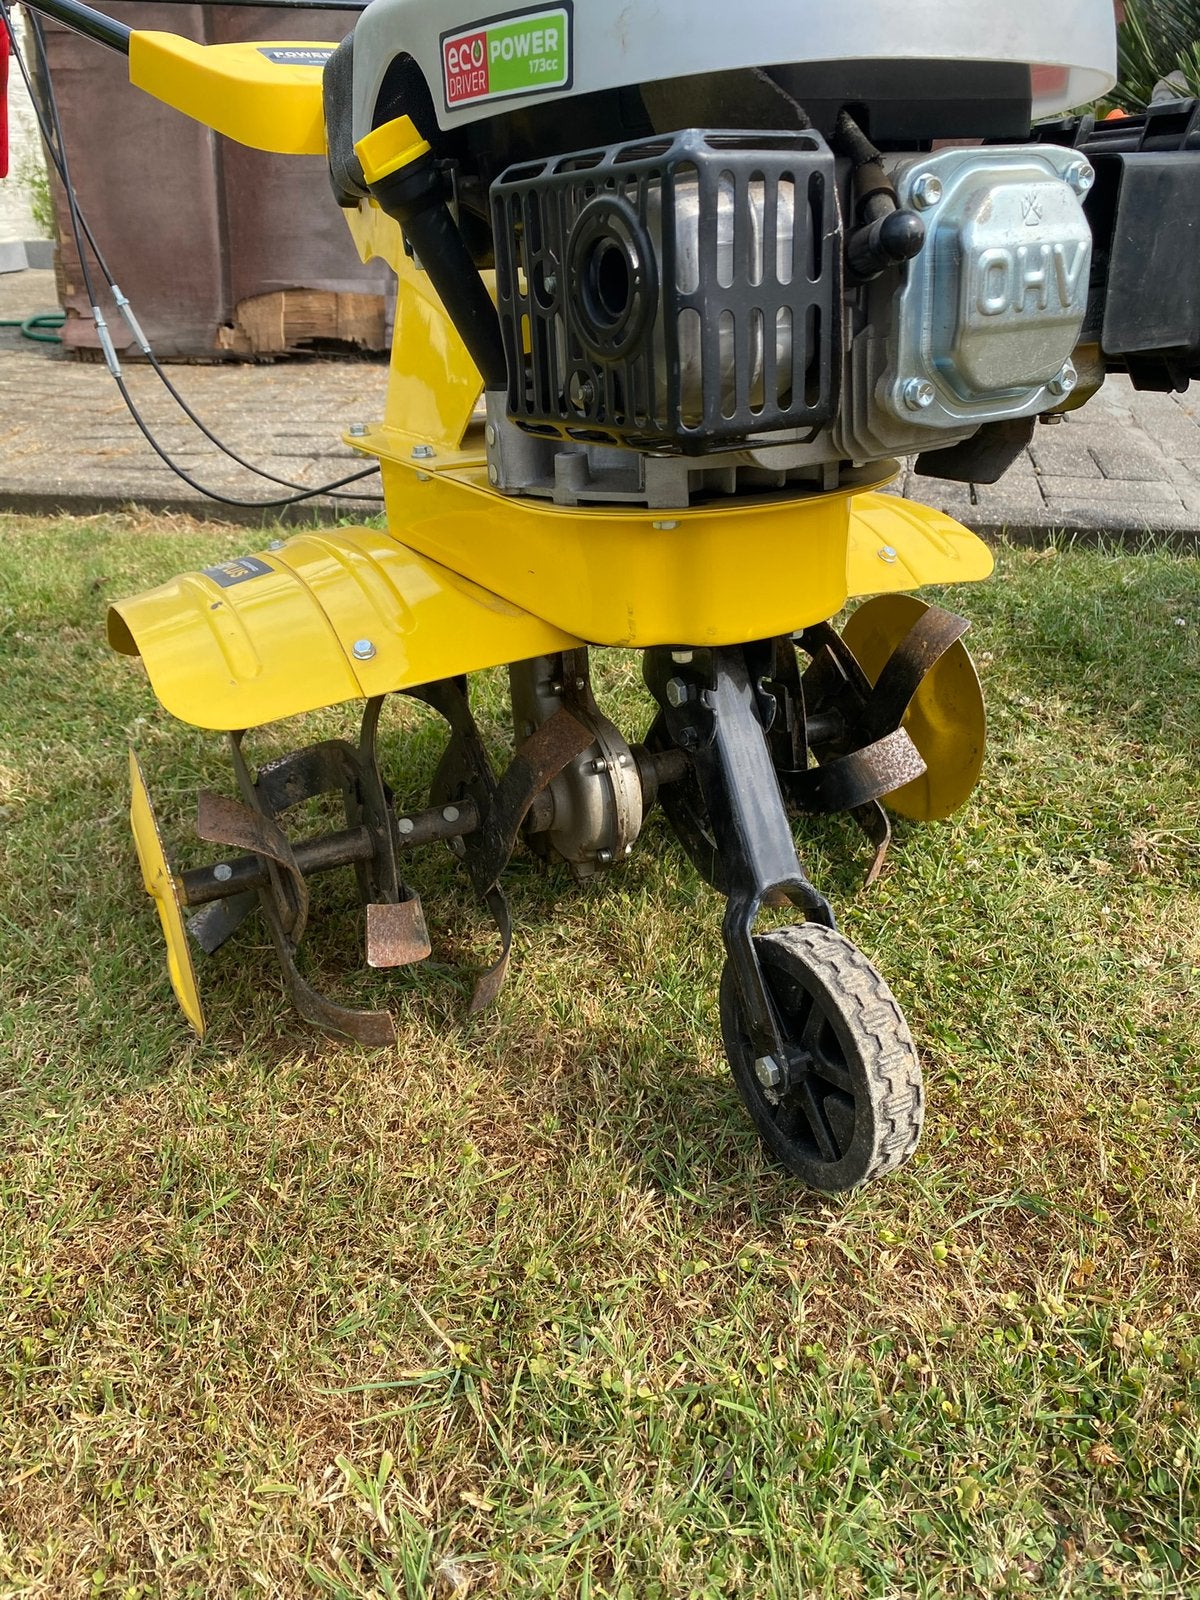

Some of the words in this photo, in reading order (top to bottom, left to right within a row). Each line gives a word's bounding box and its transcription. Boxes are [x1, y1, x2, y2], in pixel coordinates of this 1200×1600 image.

[490, 28, 559, 63] POWER
[528, 58, 558, 74] 173cc
[449, 70, 486, 97] DRIVER
[976, 241, 1088, 317] OHV
